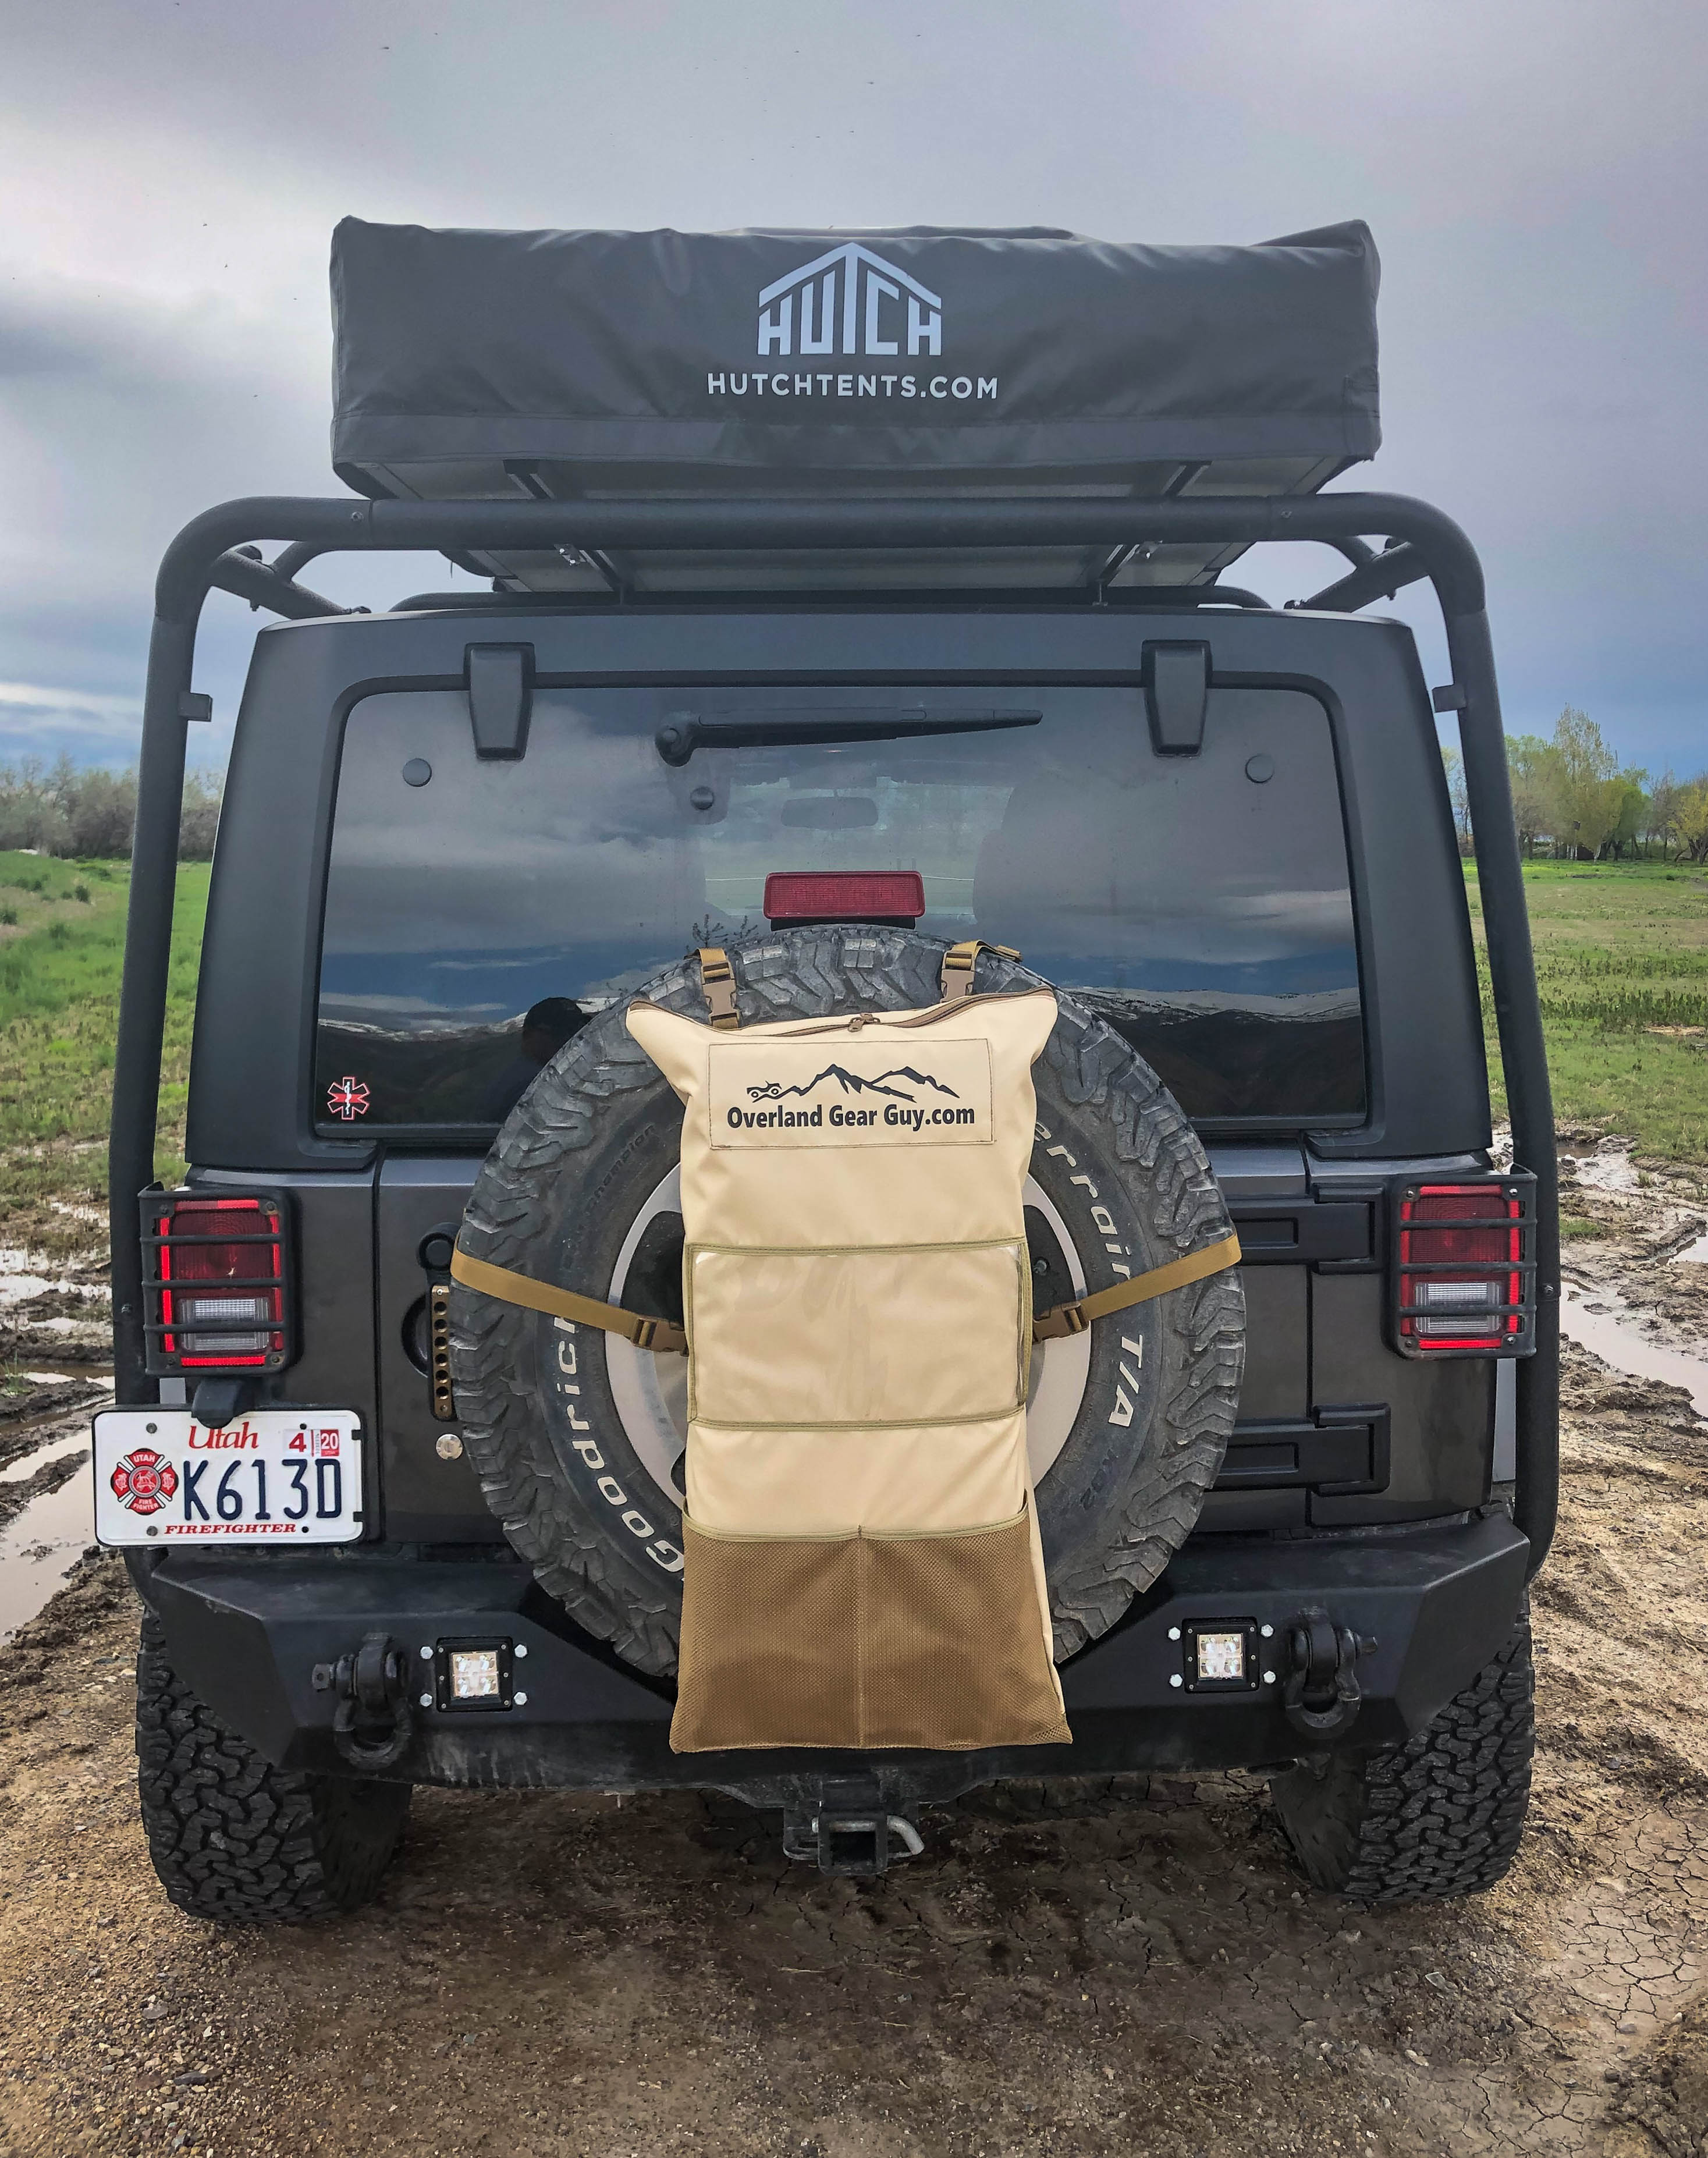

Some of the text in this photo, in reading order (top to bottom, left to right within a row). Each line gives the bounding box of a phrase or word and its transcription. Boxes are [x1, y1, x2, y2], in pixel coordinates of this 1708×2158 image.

[758, 242, 942, 356] HUTCH
[707, 372, 998, 399] HUTCHTENTS.COM
[727, 1104, 975, 1131] Overland Gear Guy.com
[1108, 1334, 1142, 1427] T/A
[188, 1421, 259, 1449] Utah
[289, 1432, 307, 1453] 4
[321, 1433, 339, 1450] 20
[133, 1454, 156, 1463] UTAH
[183, 1458, 343, 1521] K613D
[164, 1523, 297, 1535] FIREFIGHTER
